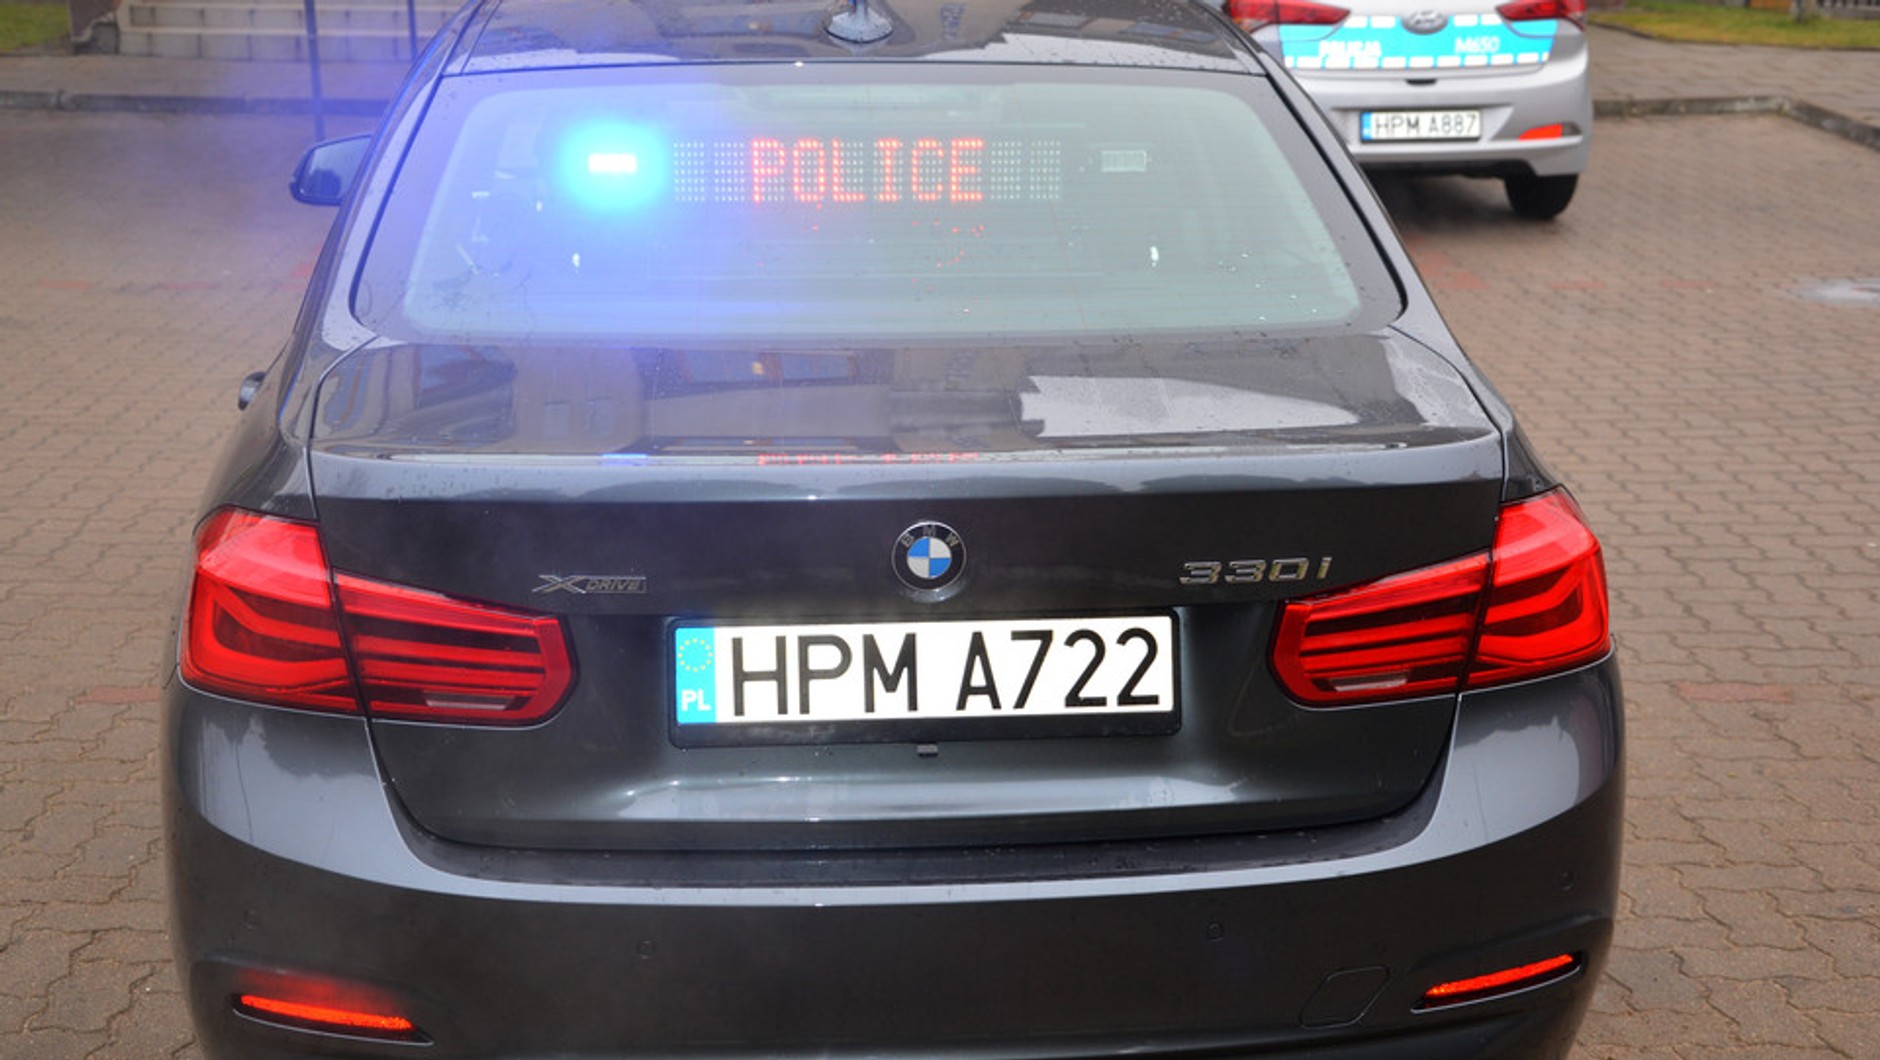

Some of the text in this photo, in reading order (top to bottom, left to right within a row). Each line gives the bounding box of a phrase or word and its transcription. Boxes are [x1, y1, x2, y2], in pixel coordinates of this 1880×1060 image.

[1318, 40, 1382, 57] POLICJA
[1375, 115, 1420, 136] HPM
[1428, 113, 1477, 135] A887
[752, 138, 984, 203] POLICE
[900, 524, 960, 548] BMW
[731, 626, 1160, 717] HPM A722
[680, 689, 712, 711] PL
